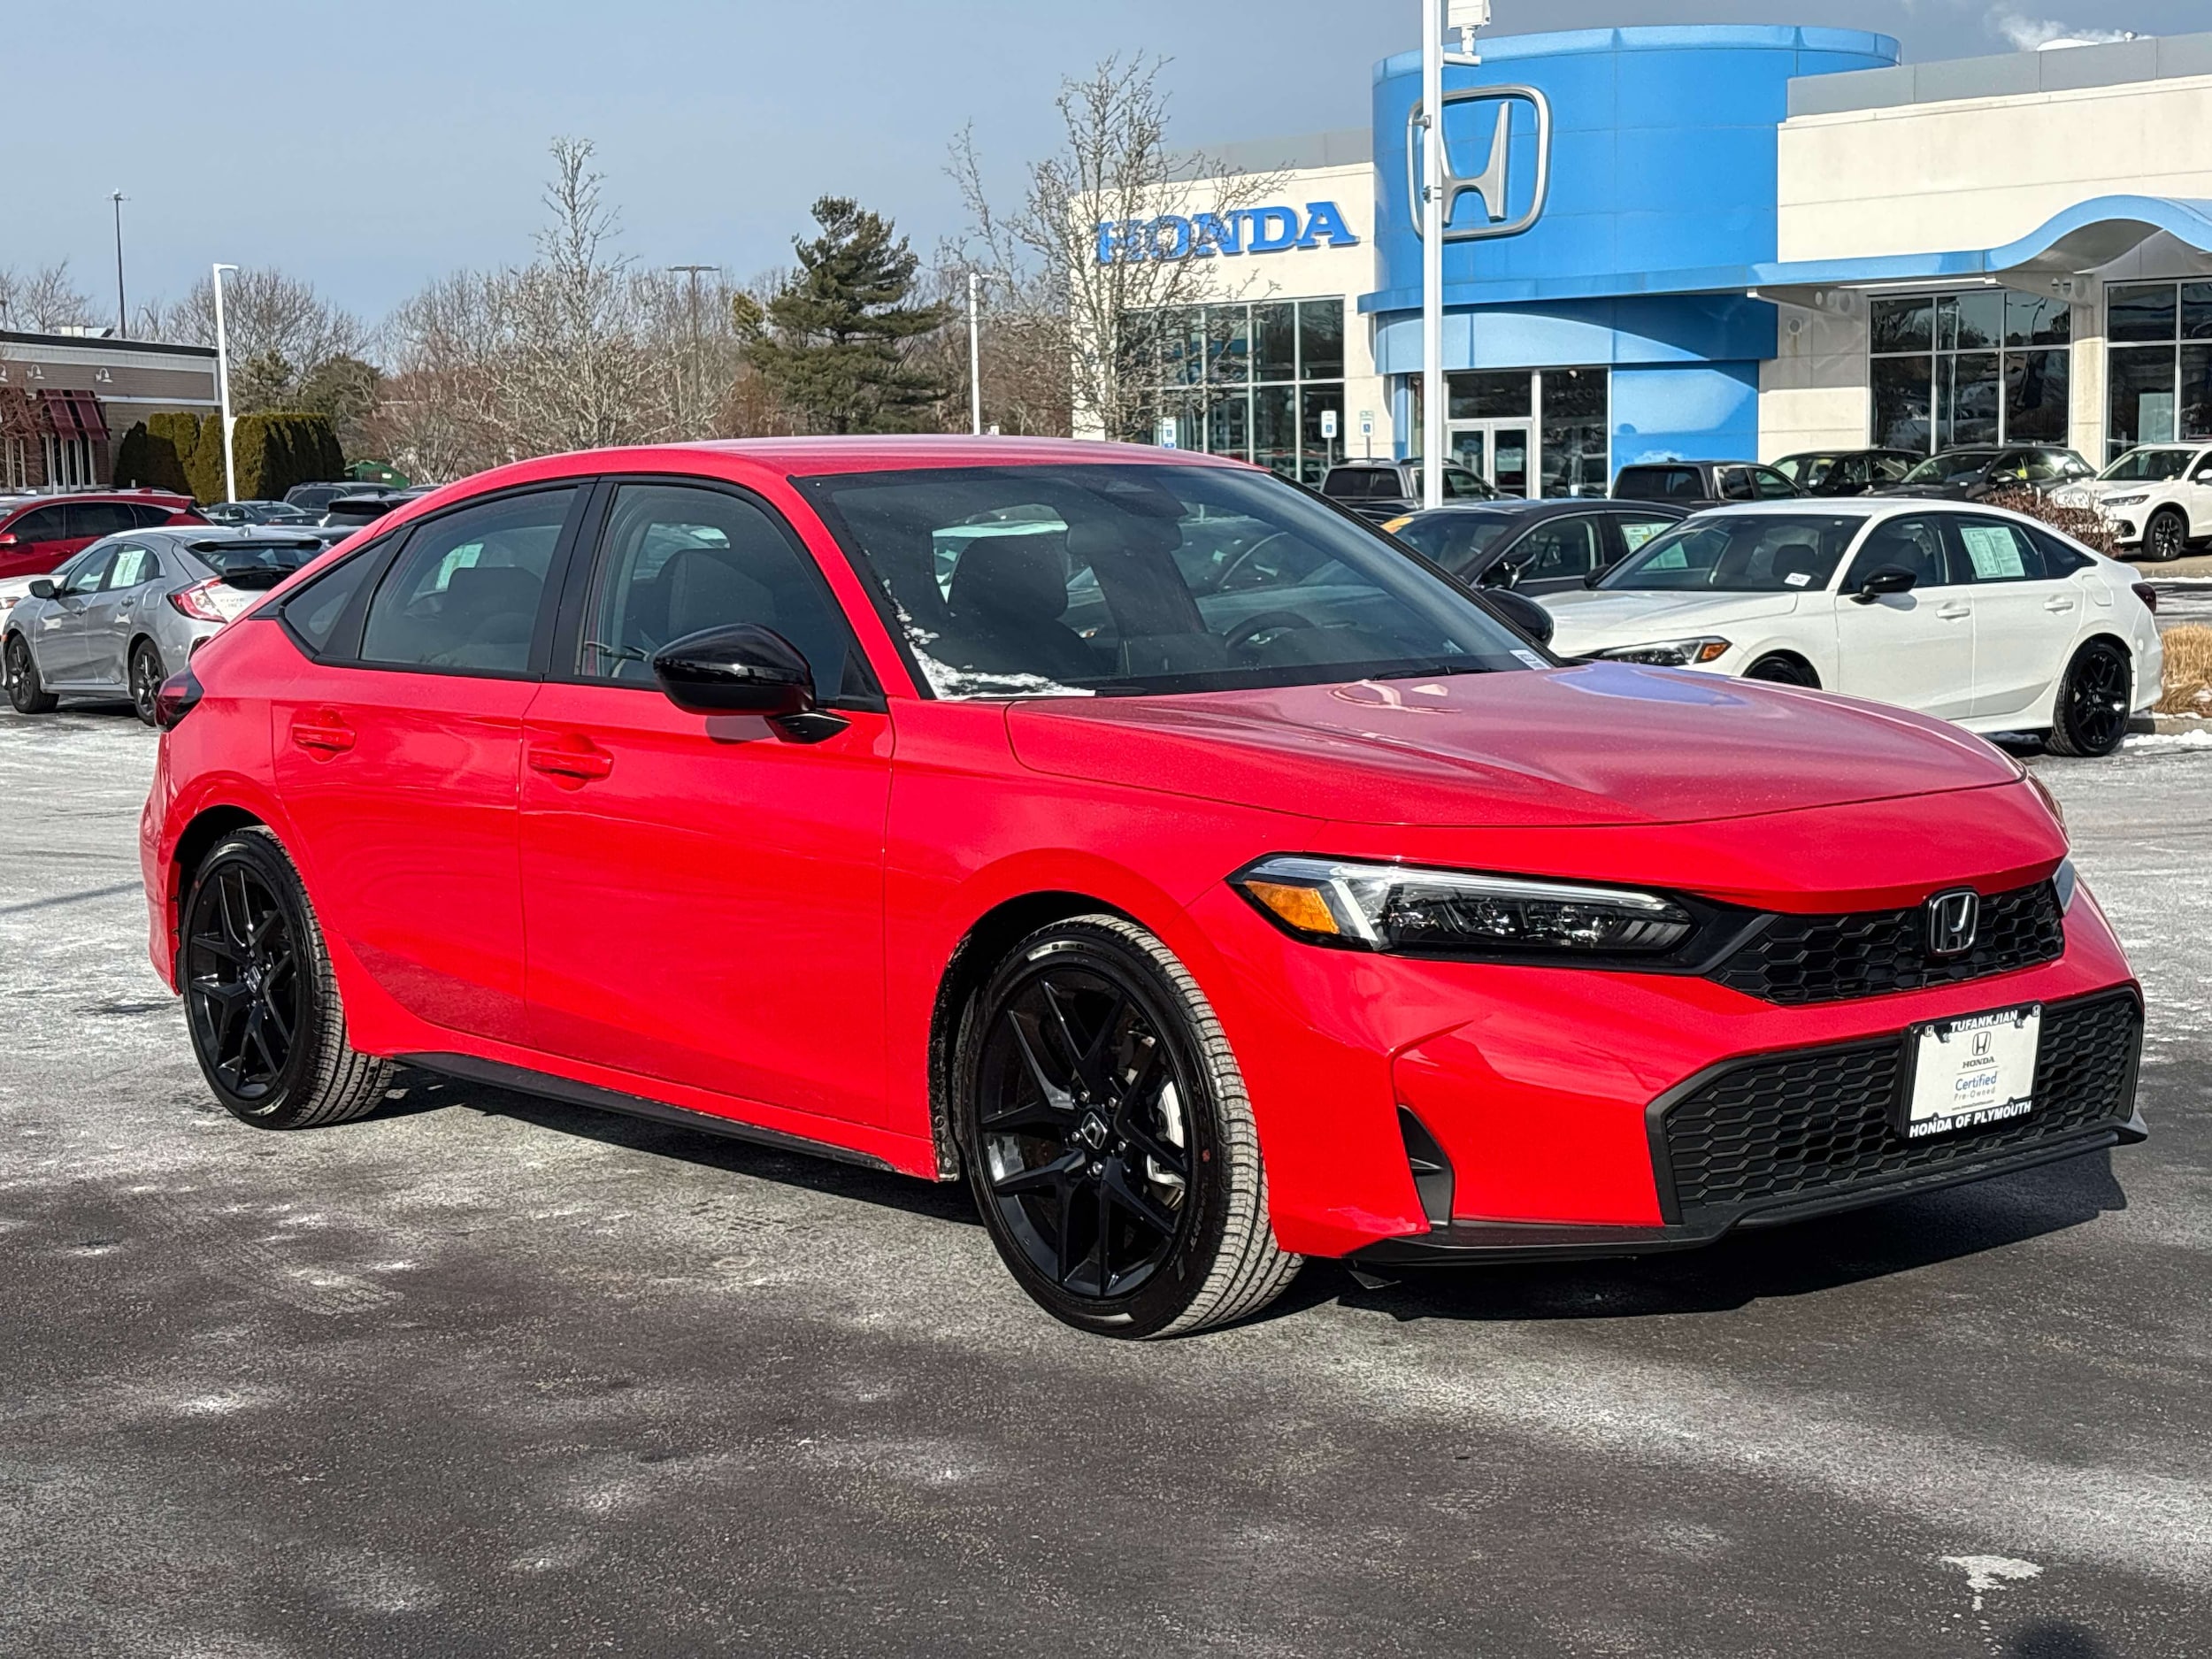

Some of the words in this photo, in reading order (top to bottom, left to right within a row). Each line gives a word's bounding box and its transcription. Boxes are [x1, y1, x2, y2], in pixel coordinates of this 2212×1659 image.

[1097, 201, 1360, 264] HONDA
[1950, 1010, 2018, 1033] TUFANKJIAN
[1962, 1056, 1995, 1069] HONDA
[1955, 1072, 1997, 1091] Certified
[1909, 1116, 1953, 1138] HONDA
[1955, 1113, 1972, 1129] OF
[1973, 1101, 2032, 1125] PLYMOUTH
